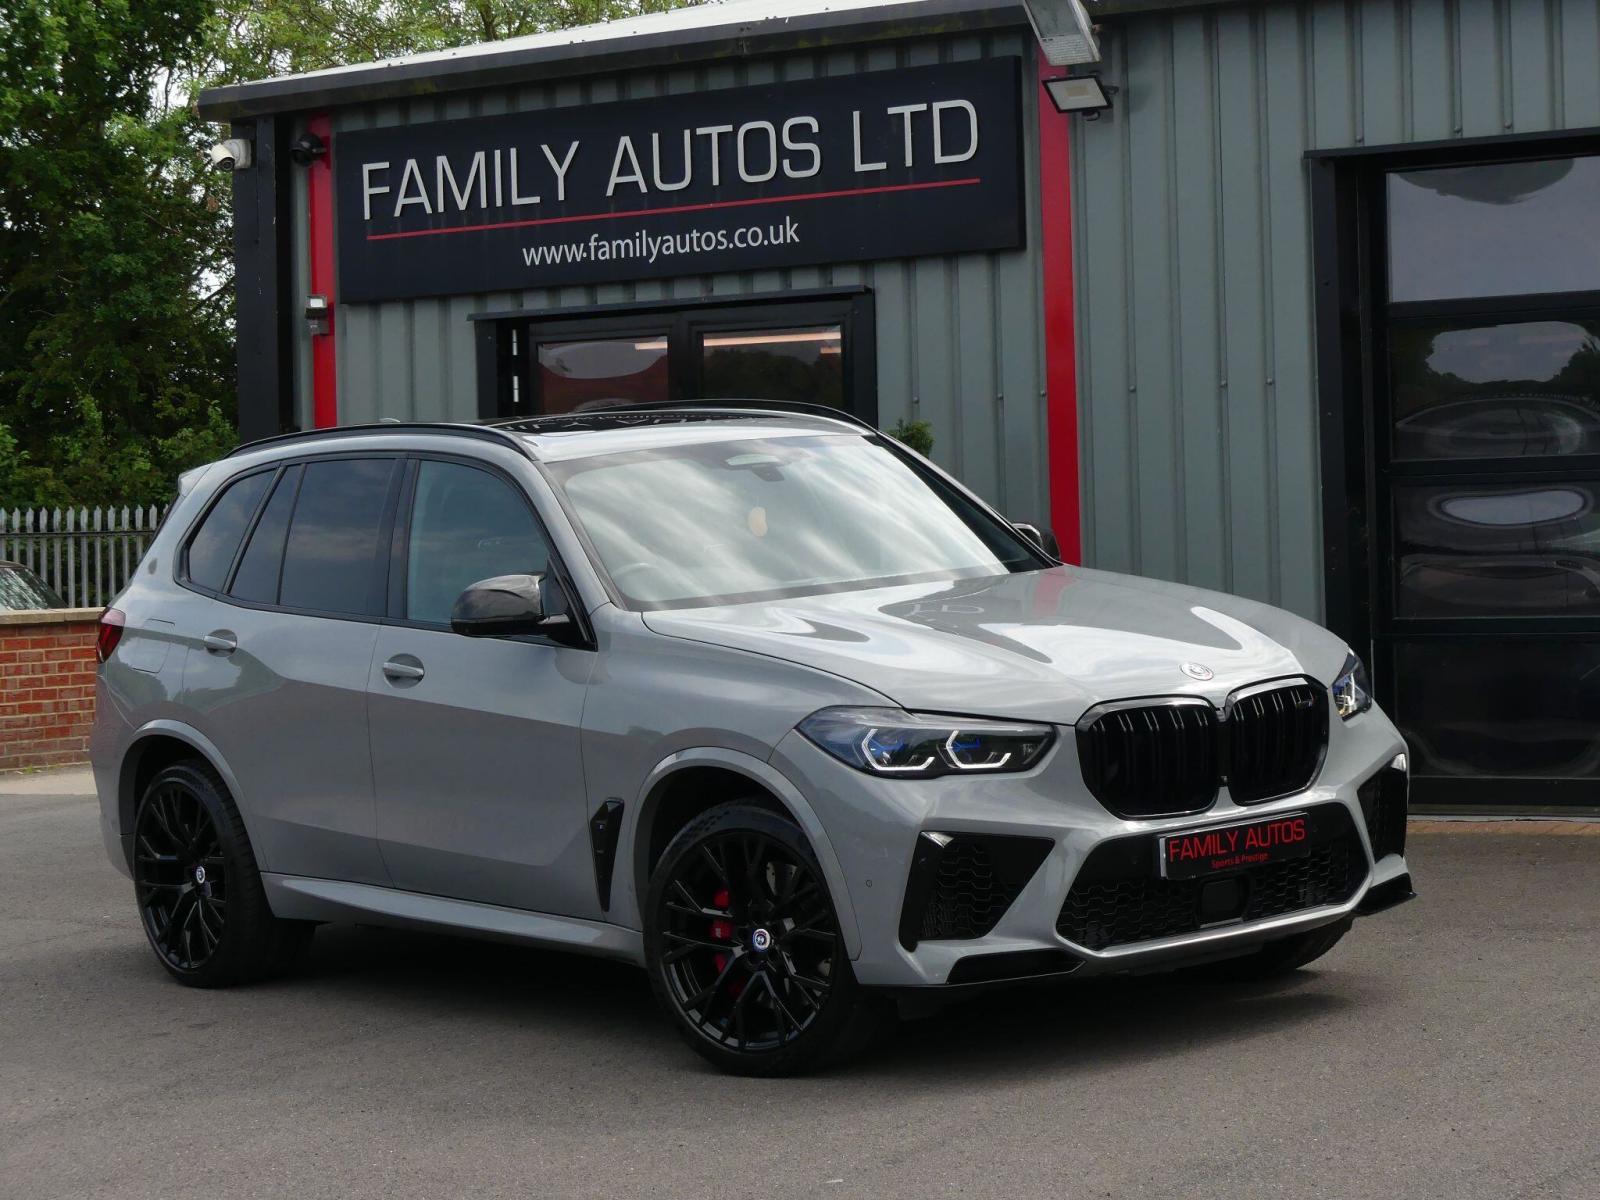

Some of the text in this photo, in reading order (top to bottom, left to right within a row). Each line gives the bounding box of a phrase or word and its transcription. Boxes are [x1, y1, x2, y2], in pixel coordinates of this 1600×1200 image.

[362, 99, 979, 220] FAMILY AUTOS LTD
[522, 215, 800, 266] www.familyautos.co.uk
[1169, 820, 1305, 862] FAMILY AUTOS
